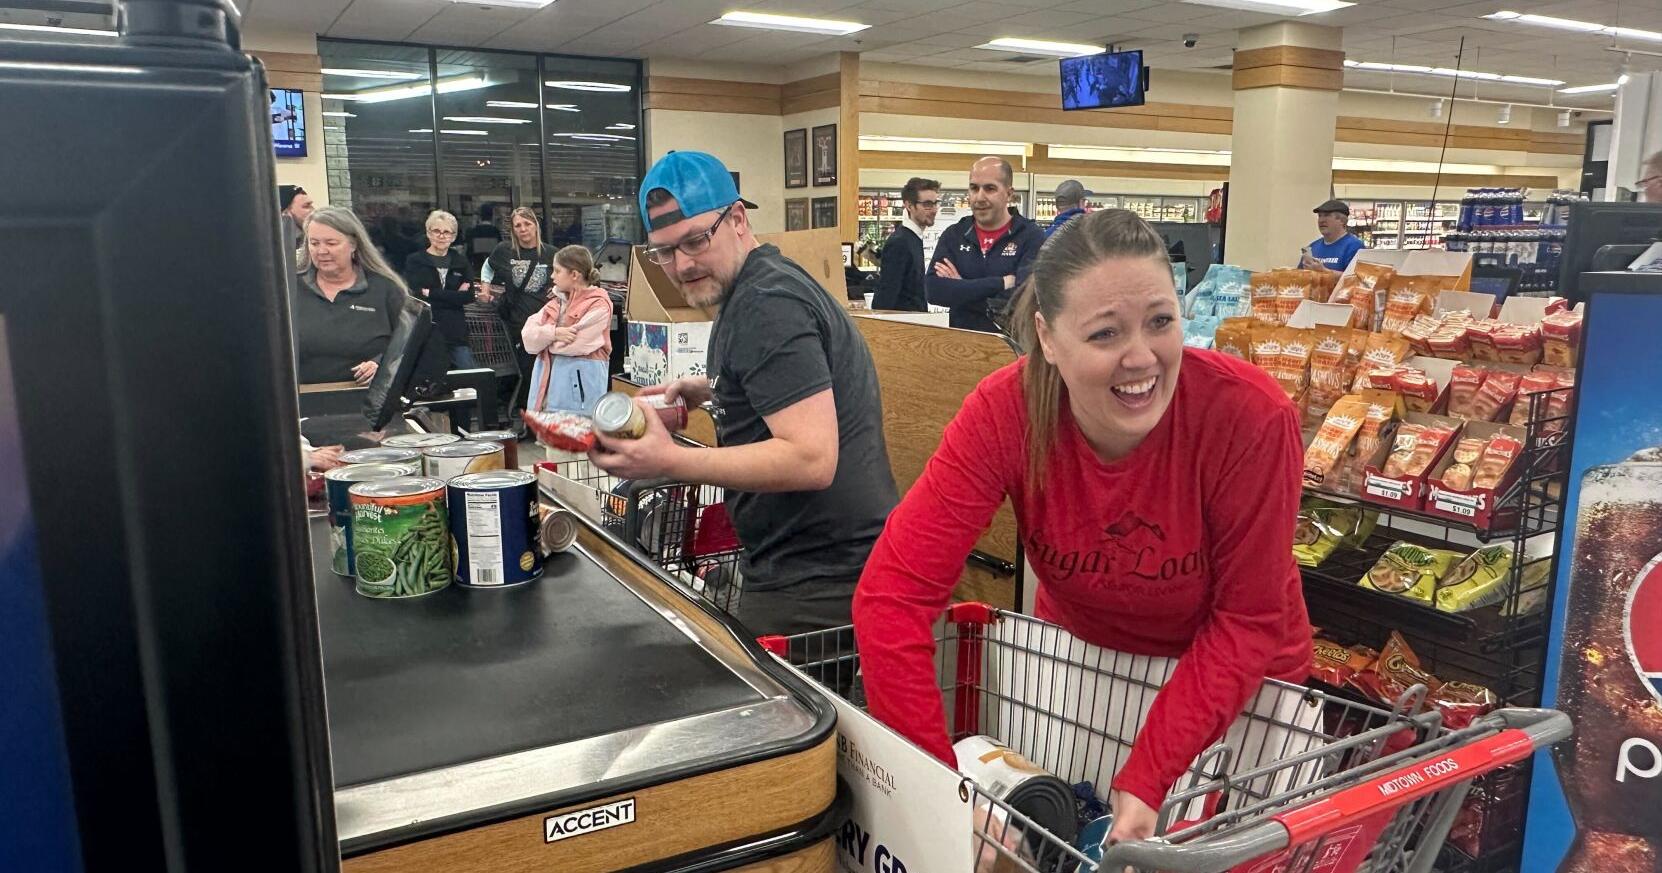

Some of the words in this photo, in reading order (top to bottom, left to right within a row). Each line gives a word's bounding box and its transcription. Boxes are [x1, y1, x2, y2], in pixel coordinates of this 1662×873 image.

[1028, 529, 1117, 581] Sugar
[850, 740, 896, 790] FINANCIAL
[1377, 771, 1425, 797] MIDTOWN
[1423, 758, 1459, 779] FOODS
[549, 803, 633, 838] ACCENT
